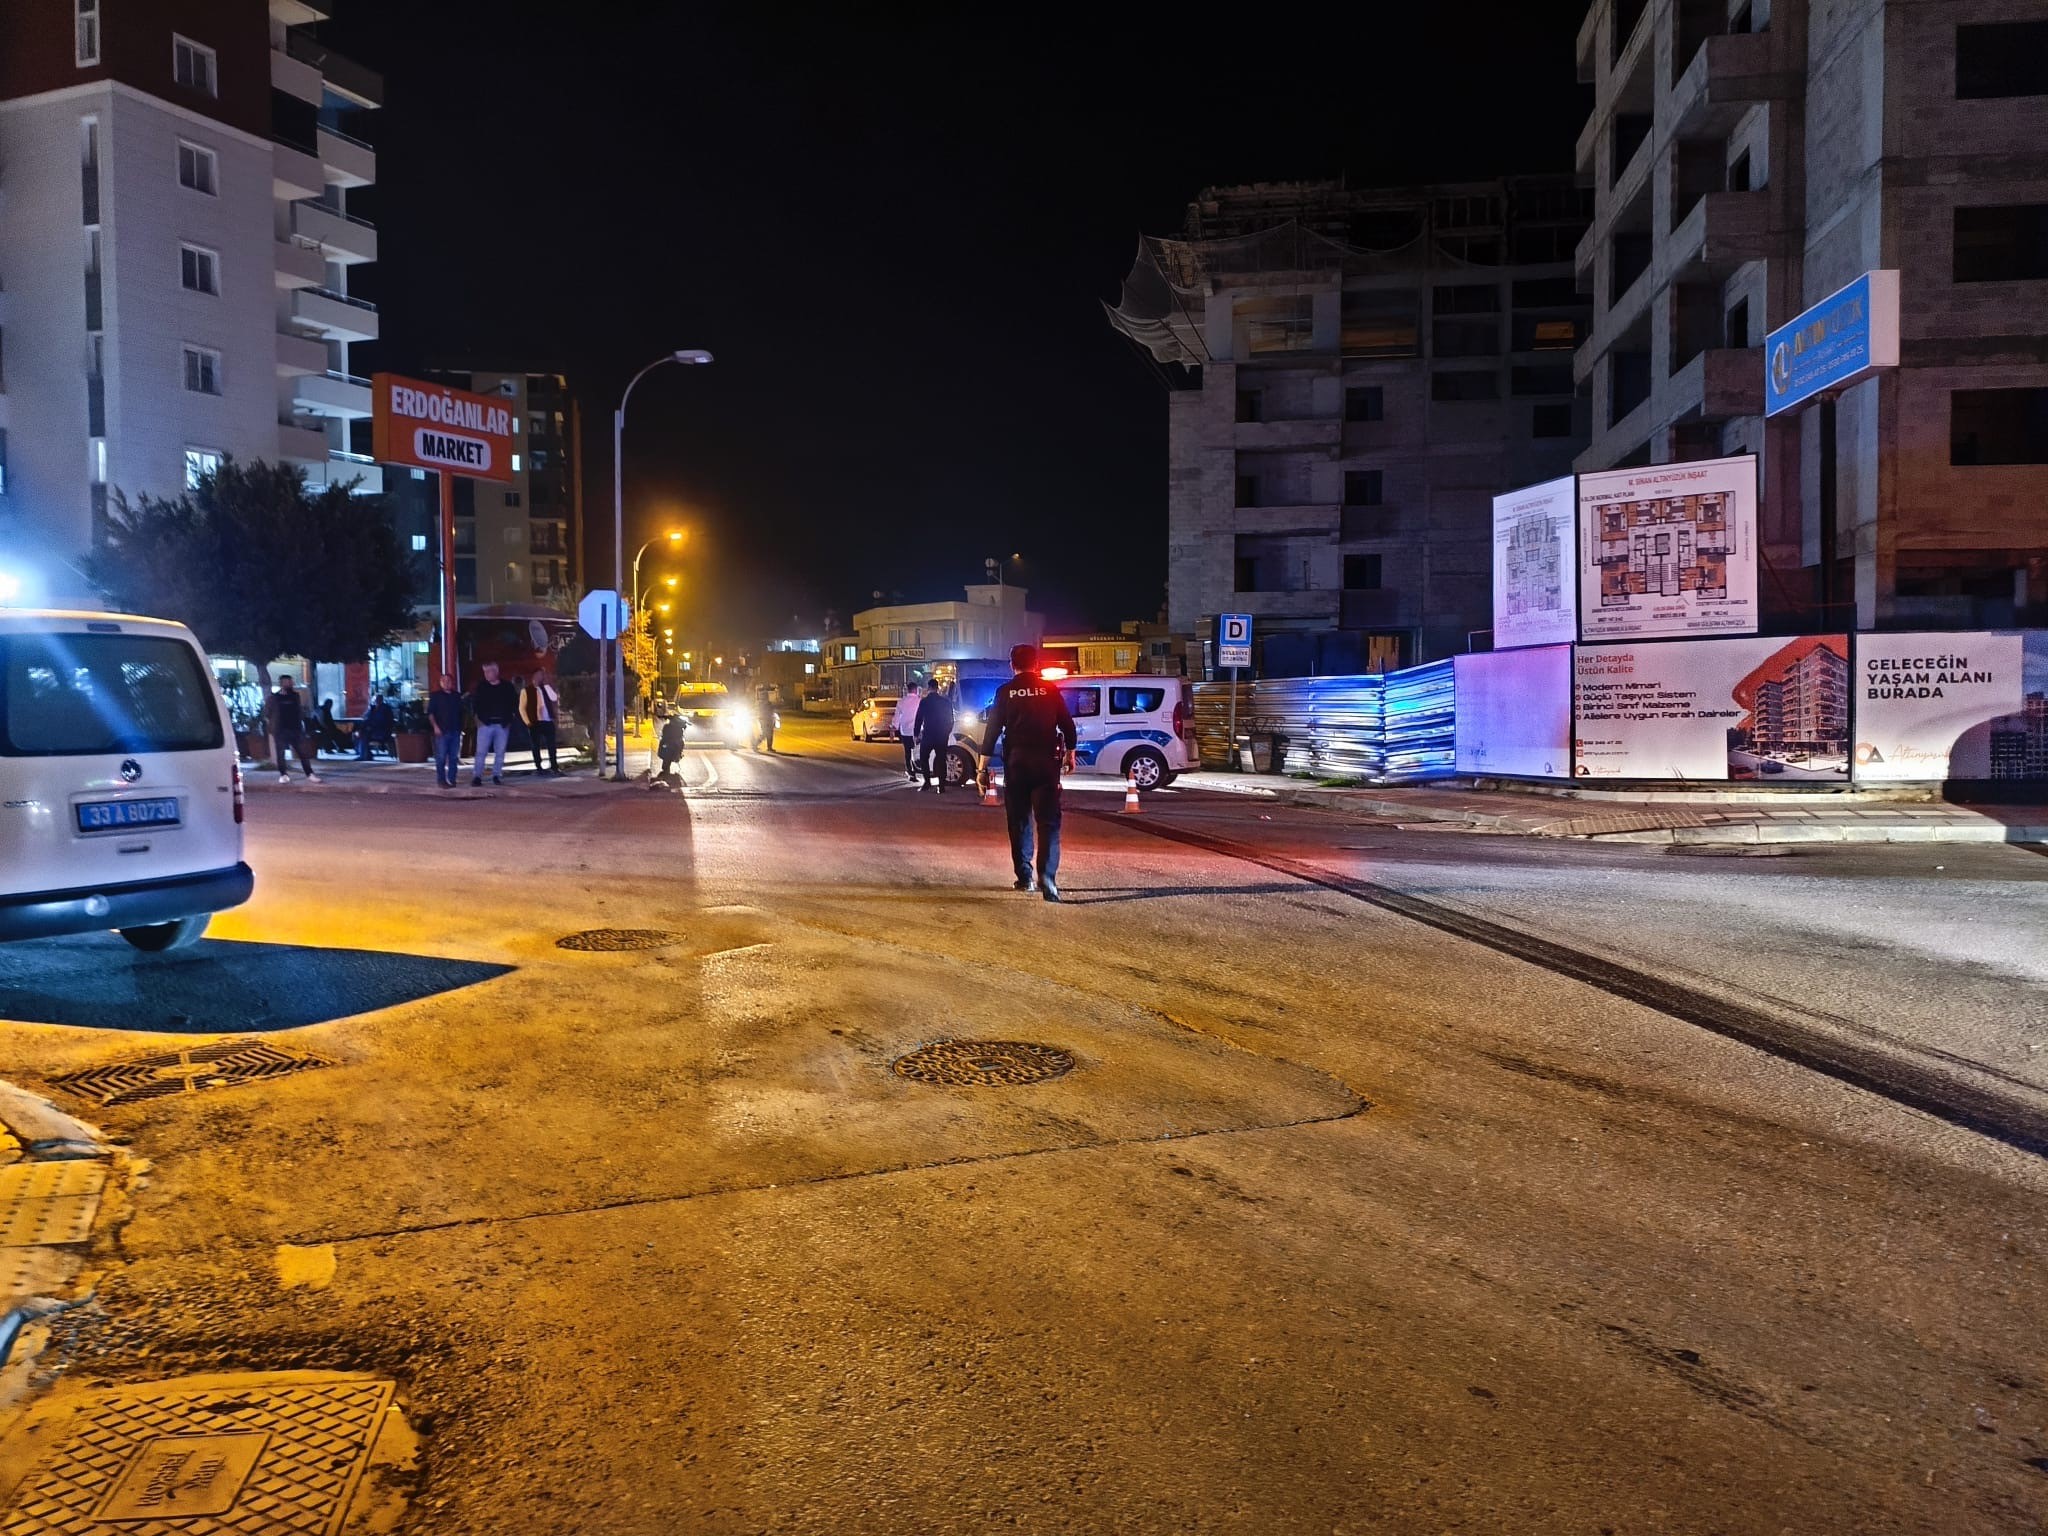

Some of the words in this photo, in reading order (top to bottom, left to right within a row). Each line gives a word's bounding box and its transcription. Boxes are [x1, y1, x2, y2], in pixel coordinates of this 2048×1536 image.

[391, 385, 509, 437] ERDOĞANLAR
[422, 432, 484, 465] MARKET
[1230, 622, 1242, 638] D
[1577, 656, 1594, 664] Her
[1596, 653, 1634, 664] Detayda
[1867, 654, 1968, 671] GELECEĞİN
[1577, 665, 1605, 675] Üstün
[1607, 664, 1634, 674] Kalite
[1583, 683, 1623, 691] Modern
[1867, 673, 1930, 688] YAŞAM
[1936, 672, 1992, 684] ALANI
[1583, 692, 1612, 702] Güçlü
[1614, 692, 1655, 701] Taşıyıcı
[1867, 687, 1944, 699] BURADA
[1583, 702, 1614, 710] Birinci
[1616, 701, 1640, 709] Sınıf
[1642, 701, 1691, 709] Malzeme
[1583, 712, 1621, 720] Ailelere
[1623, 711, 1660, 721] Uygun
[1661, 710, 1696, 718] Ferah
[1698, 709, 1742, 718] Daireler
[89, 806, 111, 825] 33
[115, 805, 126, 823] A
[134, 1450, 197, 1507] TELEKOM
